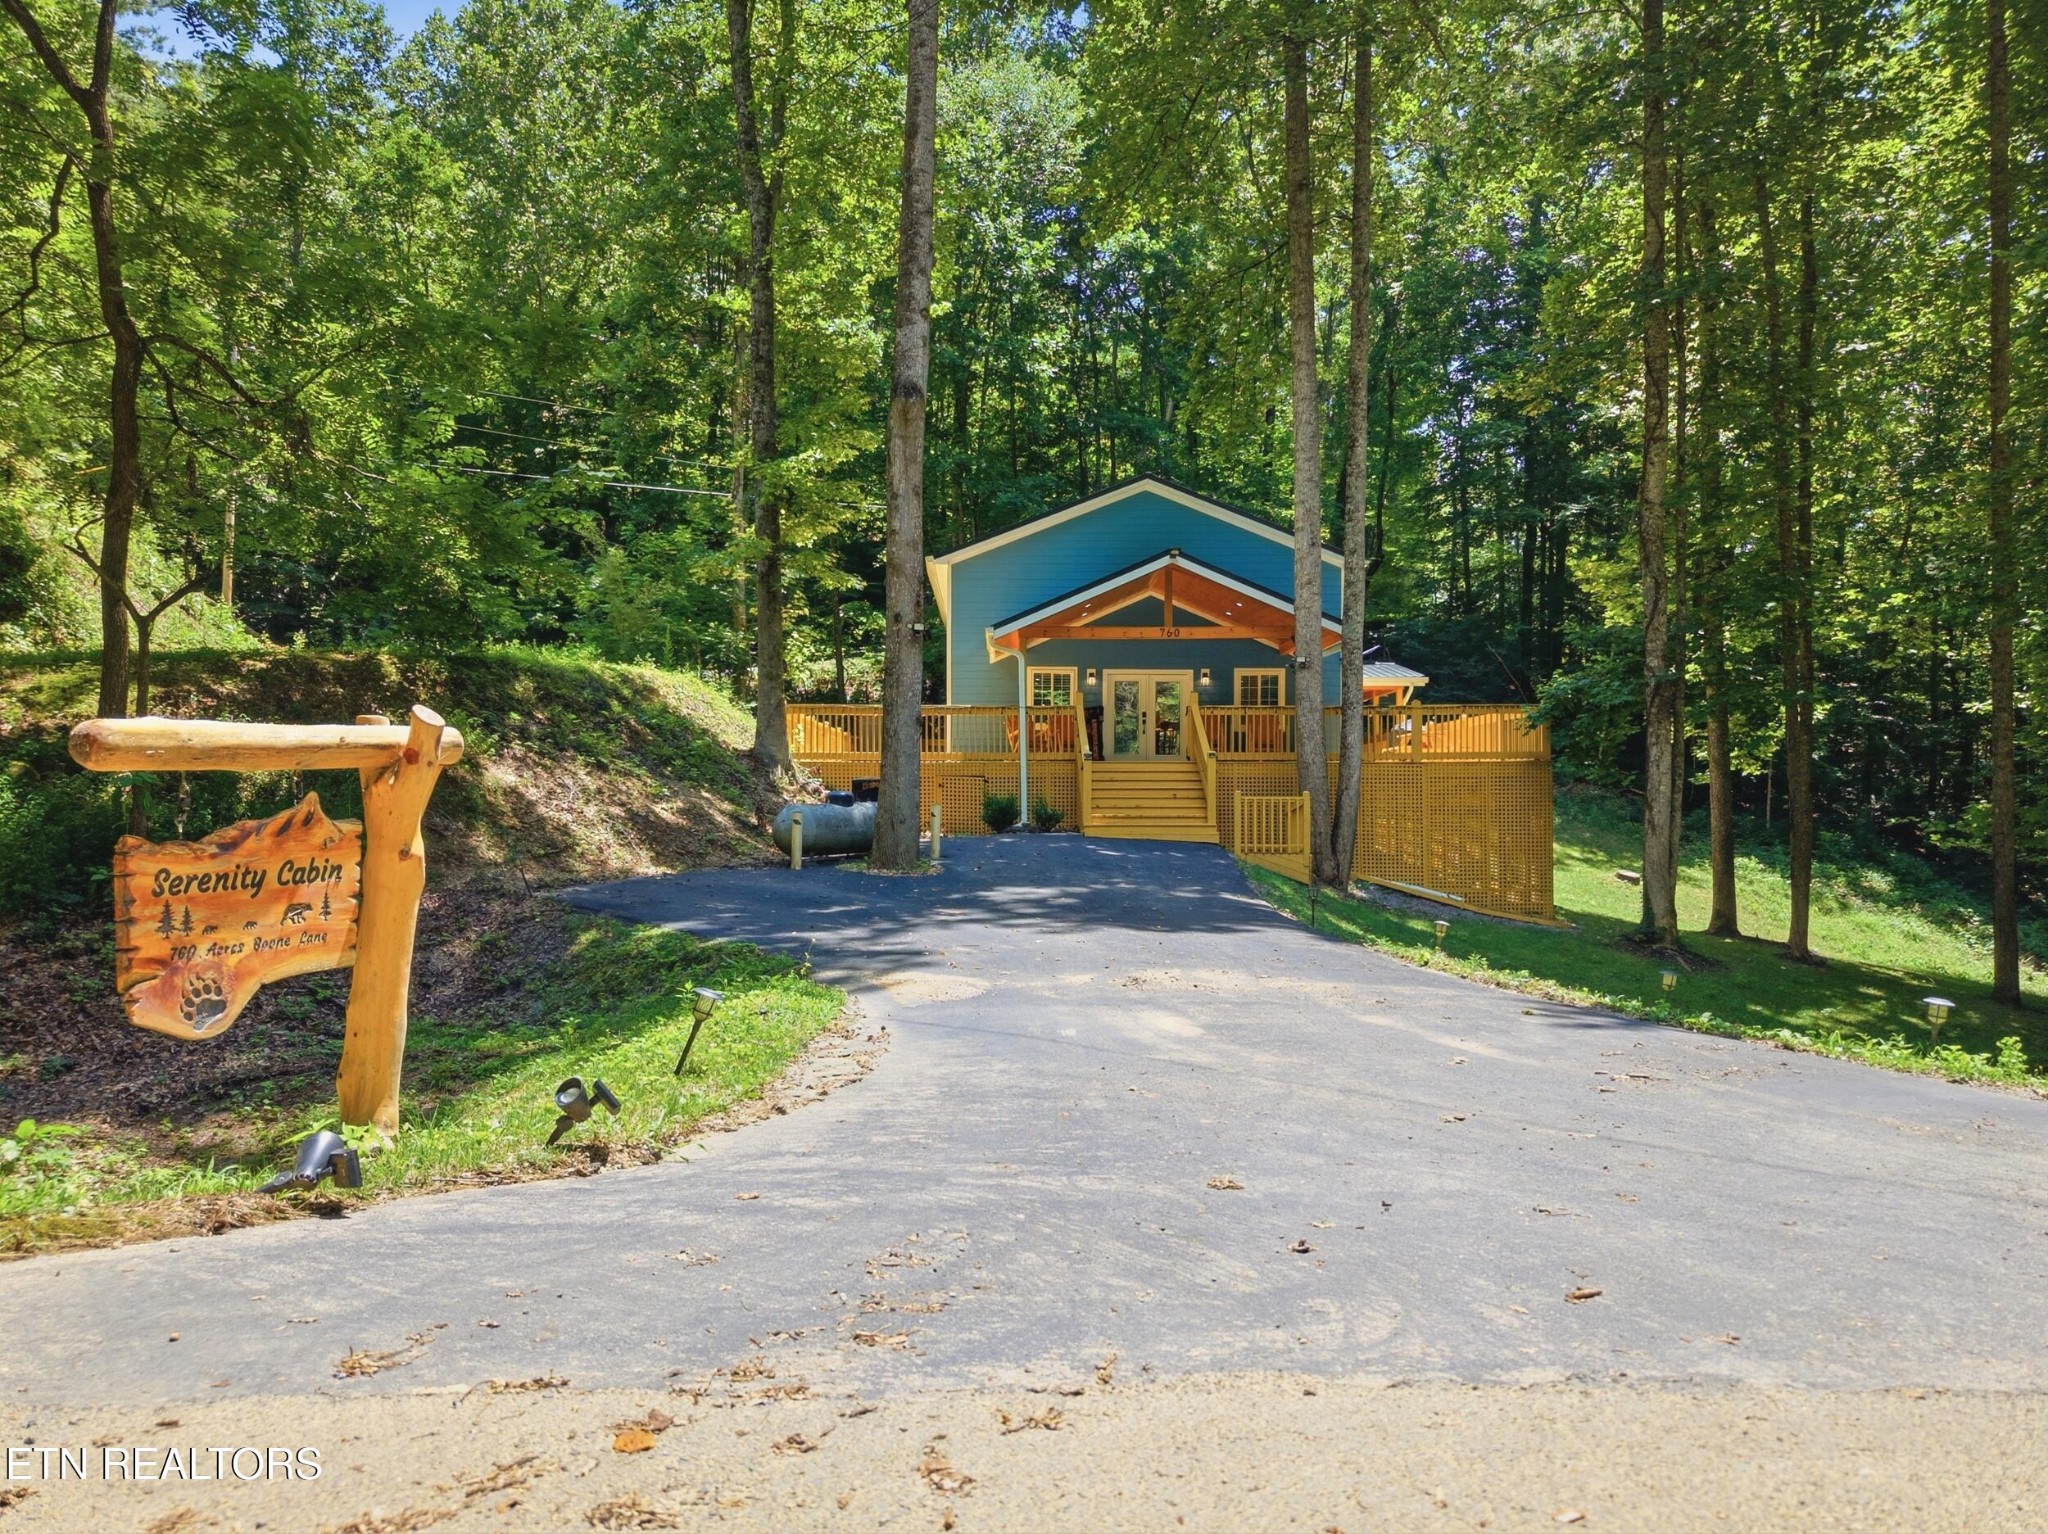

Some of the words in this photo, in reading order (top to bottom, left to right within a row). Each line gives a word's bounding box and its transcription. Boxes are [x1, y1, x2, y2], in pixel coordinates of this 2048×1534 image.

[1160, 628, 1180, 638] 760
[151, 864, 267, 899] Serenity
[277, 857, 343, 887] Cabin
[170, 944, 197, 961] 760
[299, 931, 328, 946] Lane
